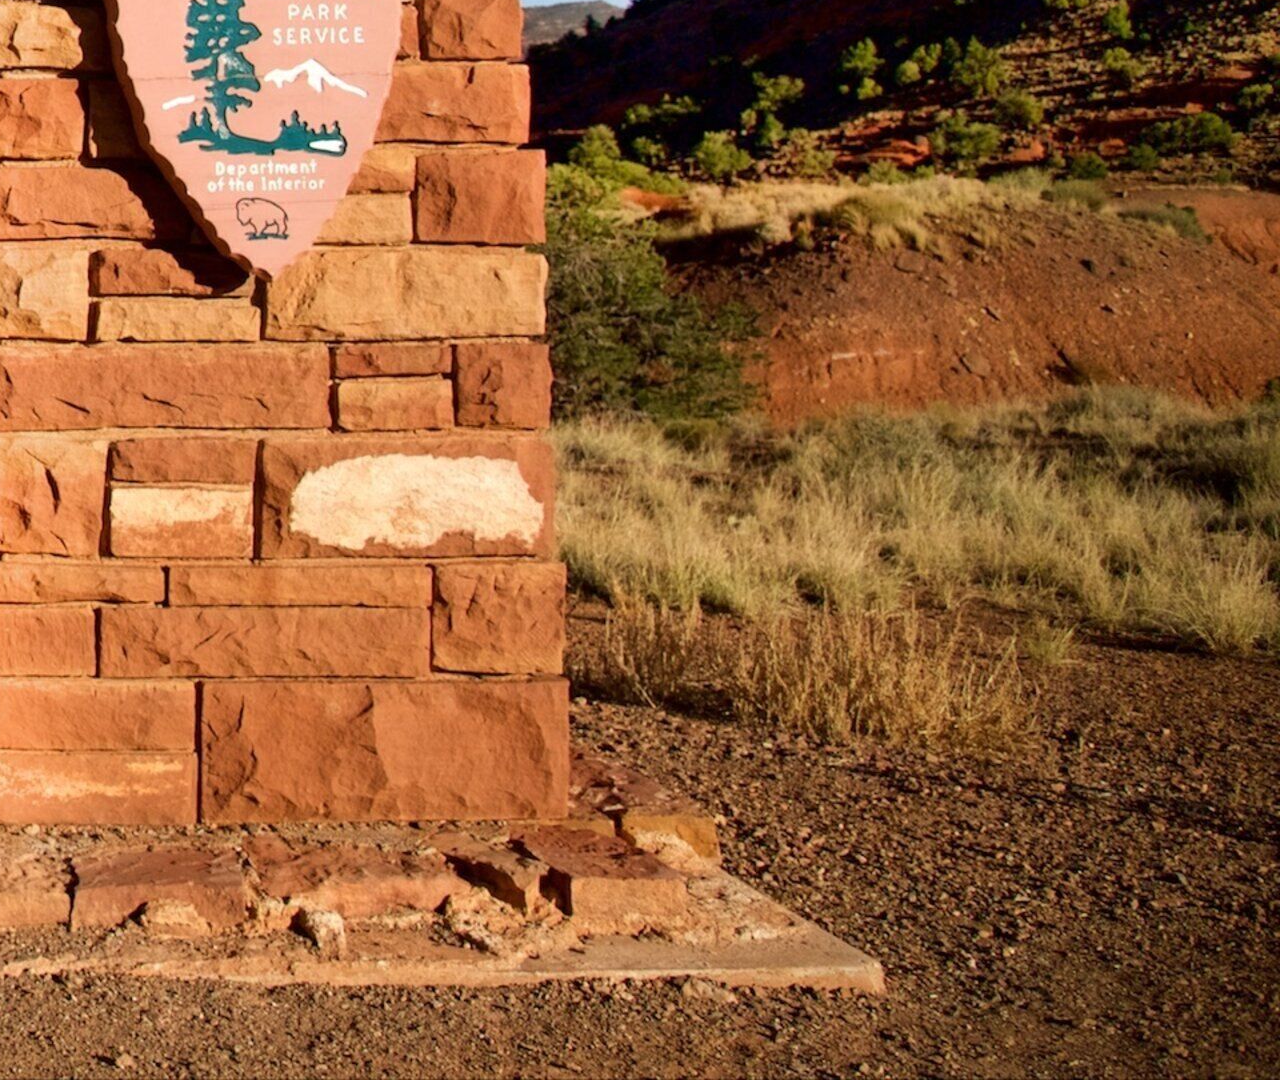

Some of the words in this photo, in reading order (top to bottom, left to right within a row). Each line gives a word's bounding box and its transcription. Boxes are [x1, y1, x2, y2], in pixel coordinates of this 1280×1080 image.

[288, 3, 348, 21] PARK
[272, 26, 365, 46] SERVICE
[215, 159, 317, 178] Department
[207, 177, 225, 193] of
[228, 177, 255, 192] the
[261, 176, 325, 192] Interior
